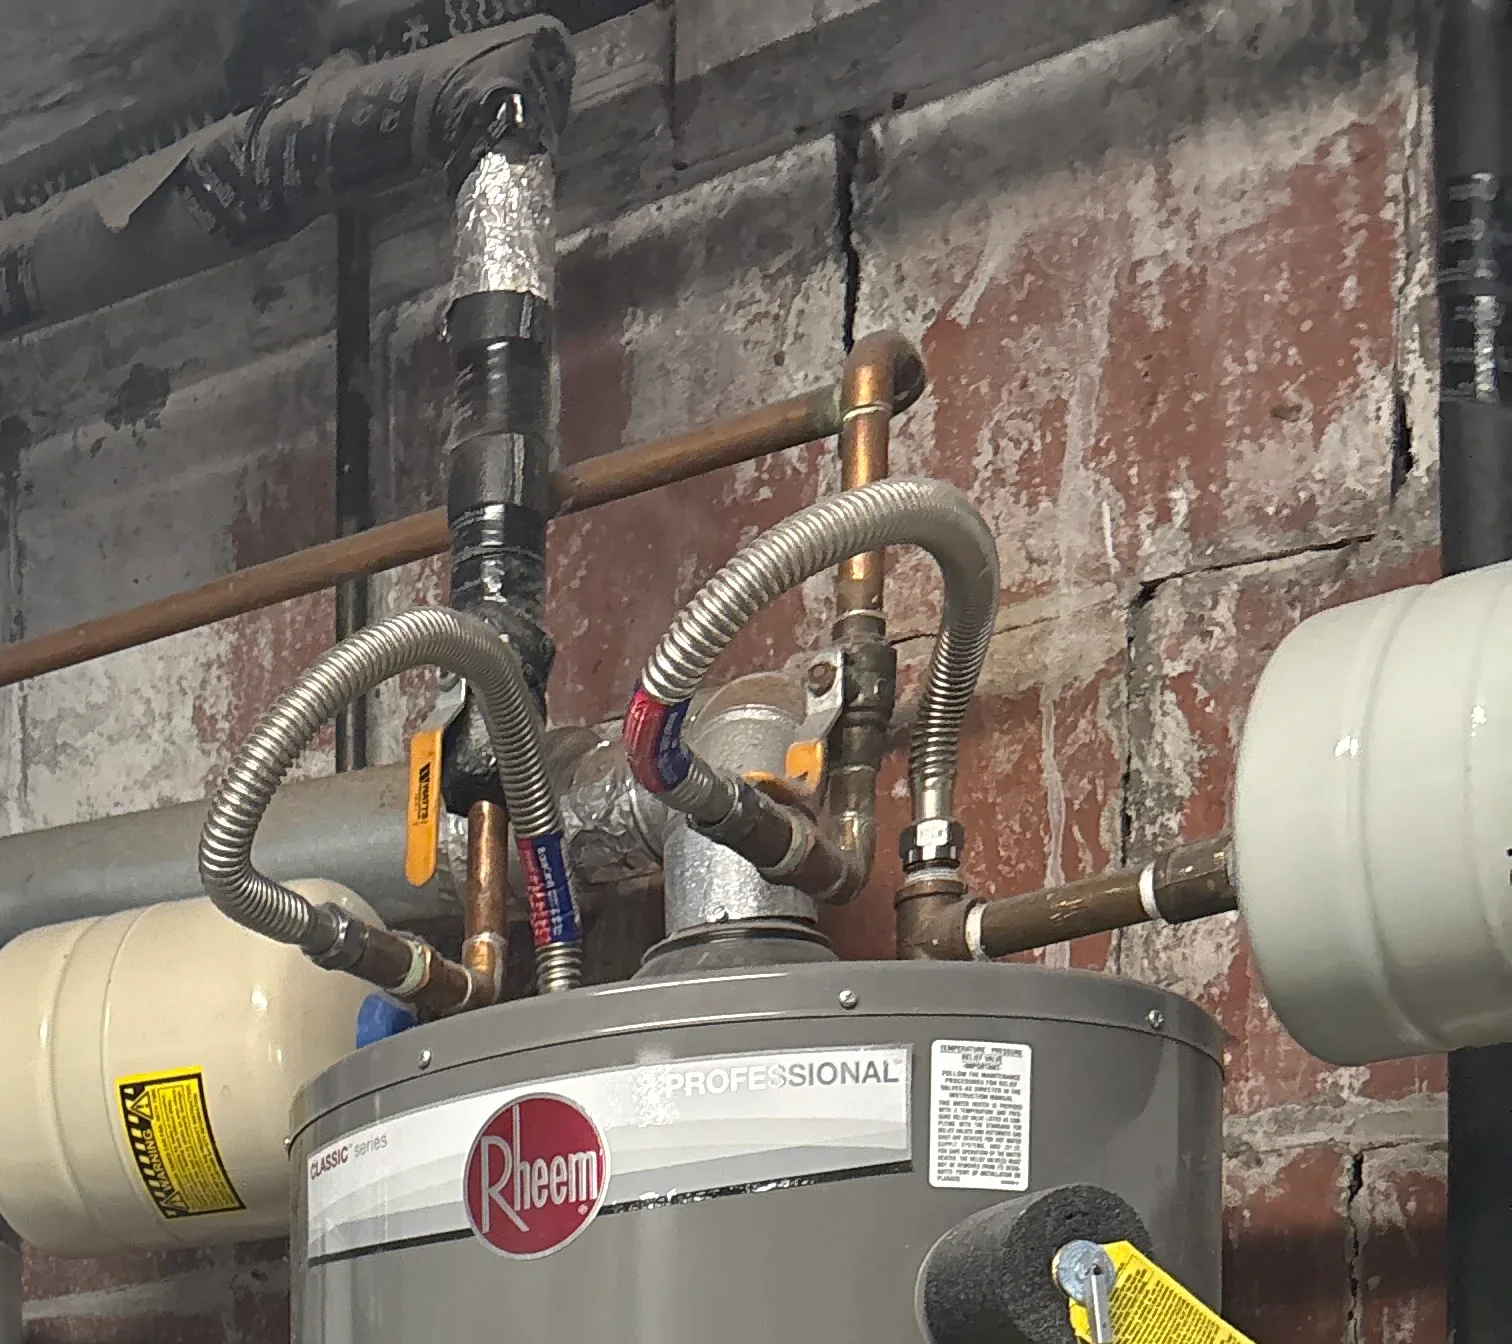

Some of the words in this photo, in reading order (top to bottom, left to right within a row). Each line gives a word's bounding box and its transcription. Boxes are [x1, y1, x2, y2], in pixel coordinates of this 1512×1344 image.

[664, 1060, 900, 1098] PROFESSIONAL
[143, 1129, 172, 1191] WARNING
[310, 1146, 349, 1180] CLASSIC
[354, 1133, 388, 1158] series
[480, 1103, 598, 1233] Rheem
